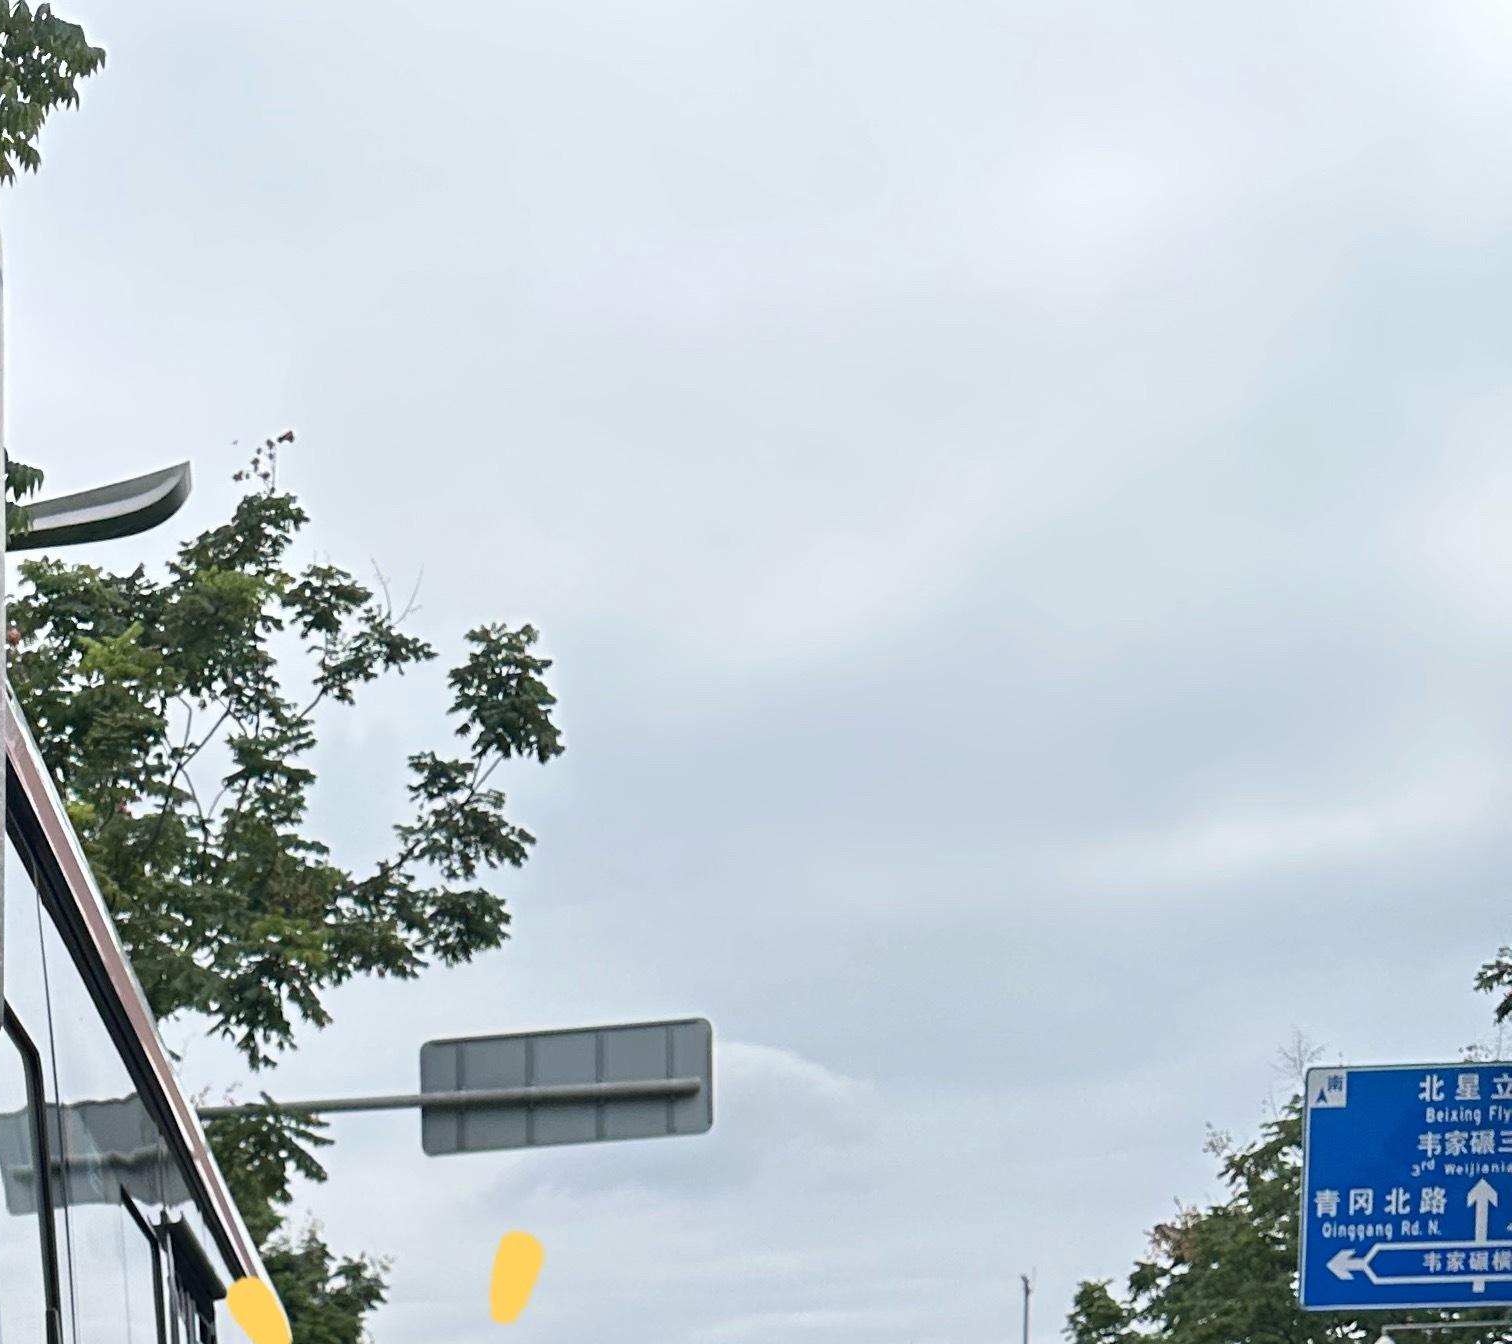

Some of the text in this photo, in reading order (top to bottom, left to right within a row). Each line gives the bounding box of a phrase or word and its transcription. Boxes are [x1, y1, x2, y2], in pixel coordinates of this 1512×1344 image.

[1425, 1107, 1481, 1126] Beixing
[1411, 1158, 1435, 1176] 3rd
[1314, 1186, 1447, 1218] 青冈北路
[1322, 1219, 1442, 1242] Qinggang Rd. N.
